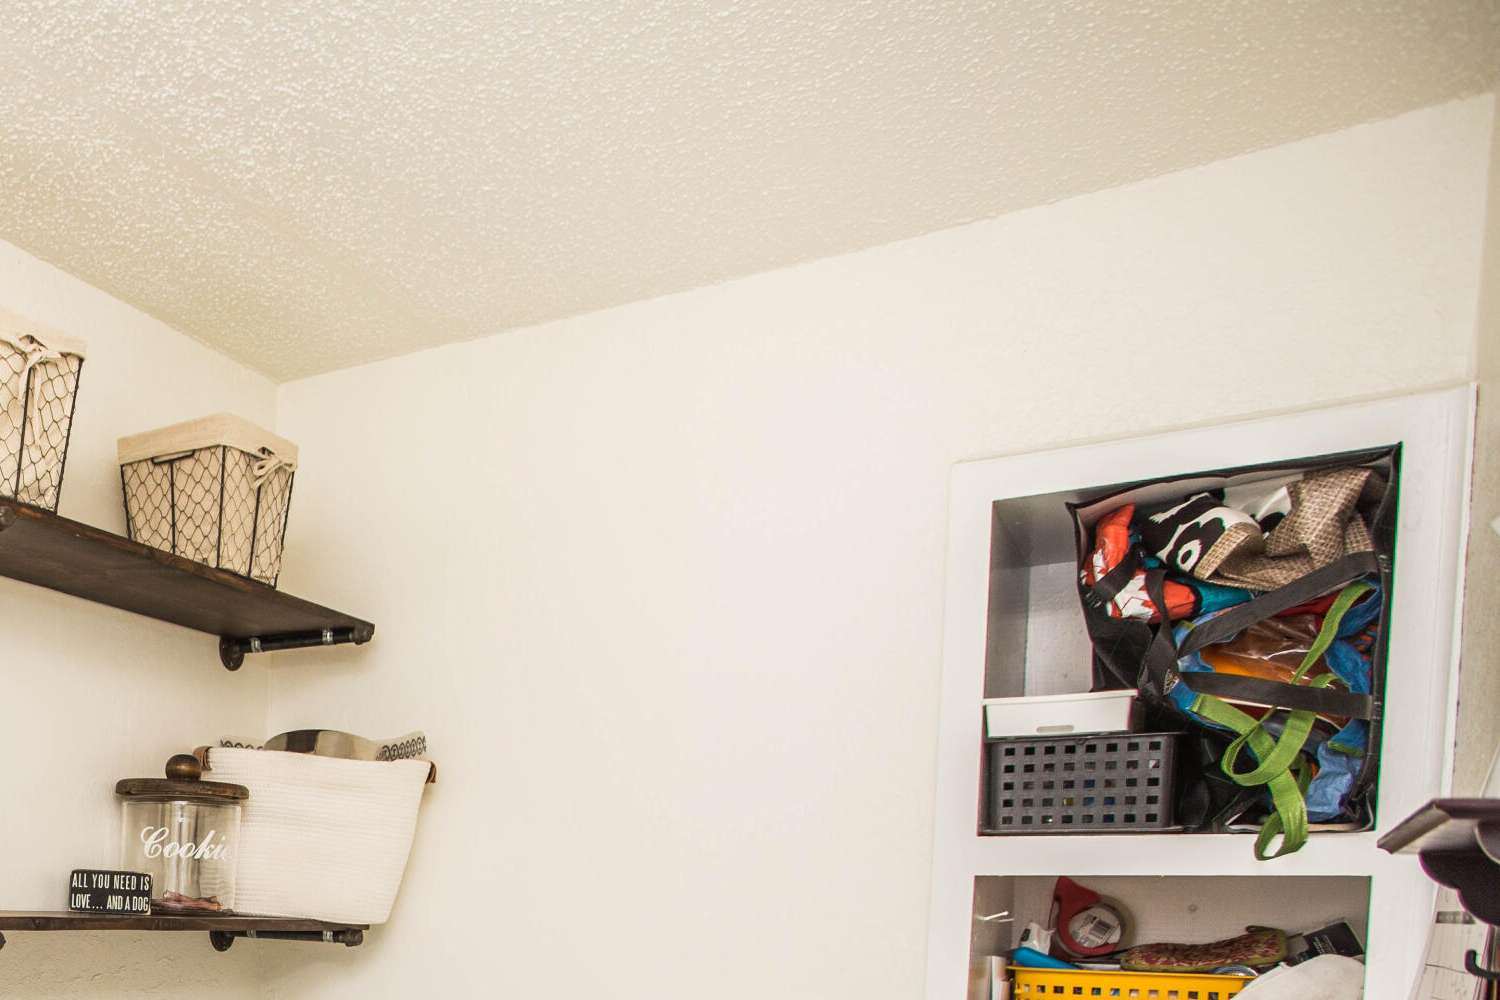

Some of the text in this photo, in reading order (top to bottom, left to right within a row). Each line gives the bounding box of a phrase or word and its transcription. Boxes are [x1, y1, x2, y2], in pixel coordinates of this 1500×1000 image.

[72, 873, 150, 891] ALL YOU NEED IS
[106, 895, 123, 910] AND
[124, 896, 131, 911] A
[132, 896, 149, 911] DOG
